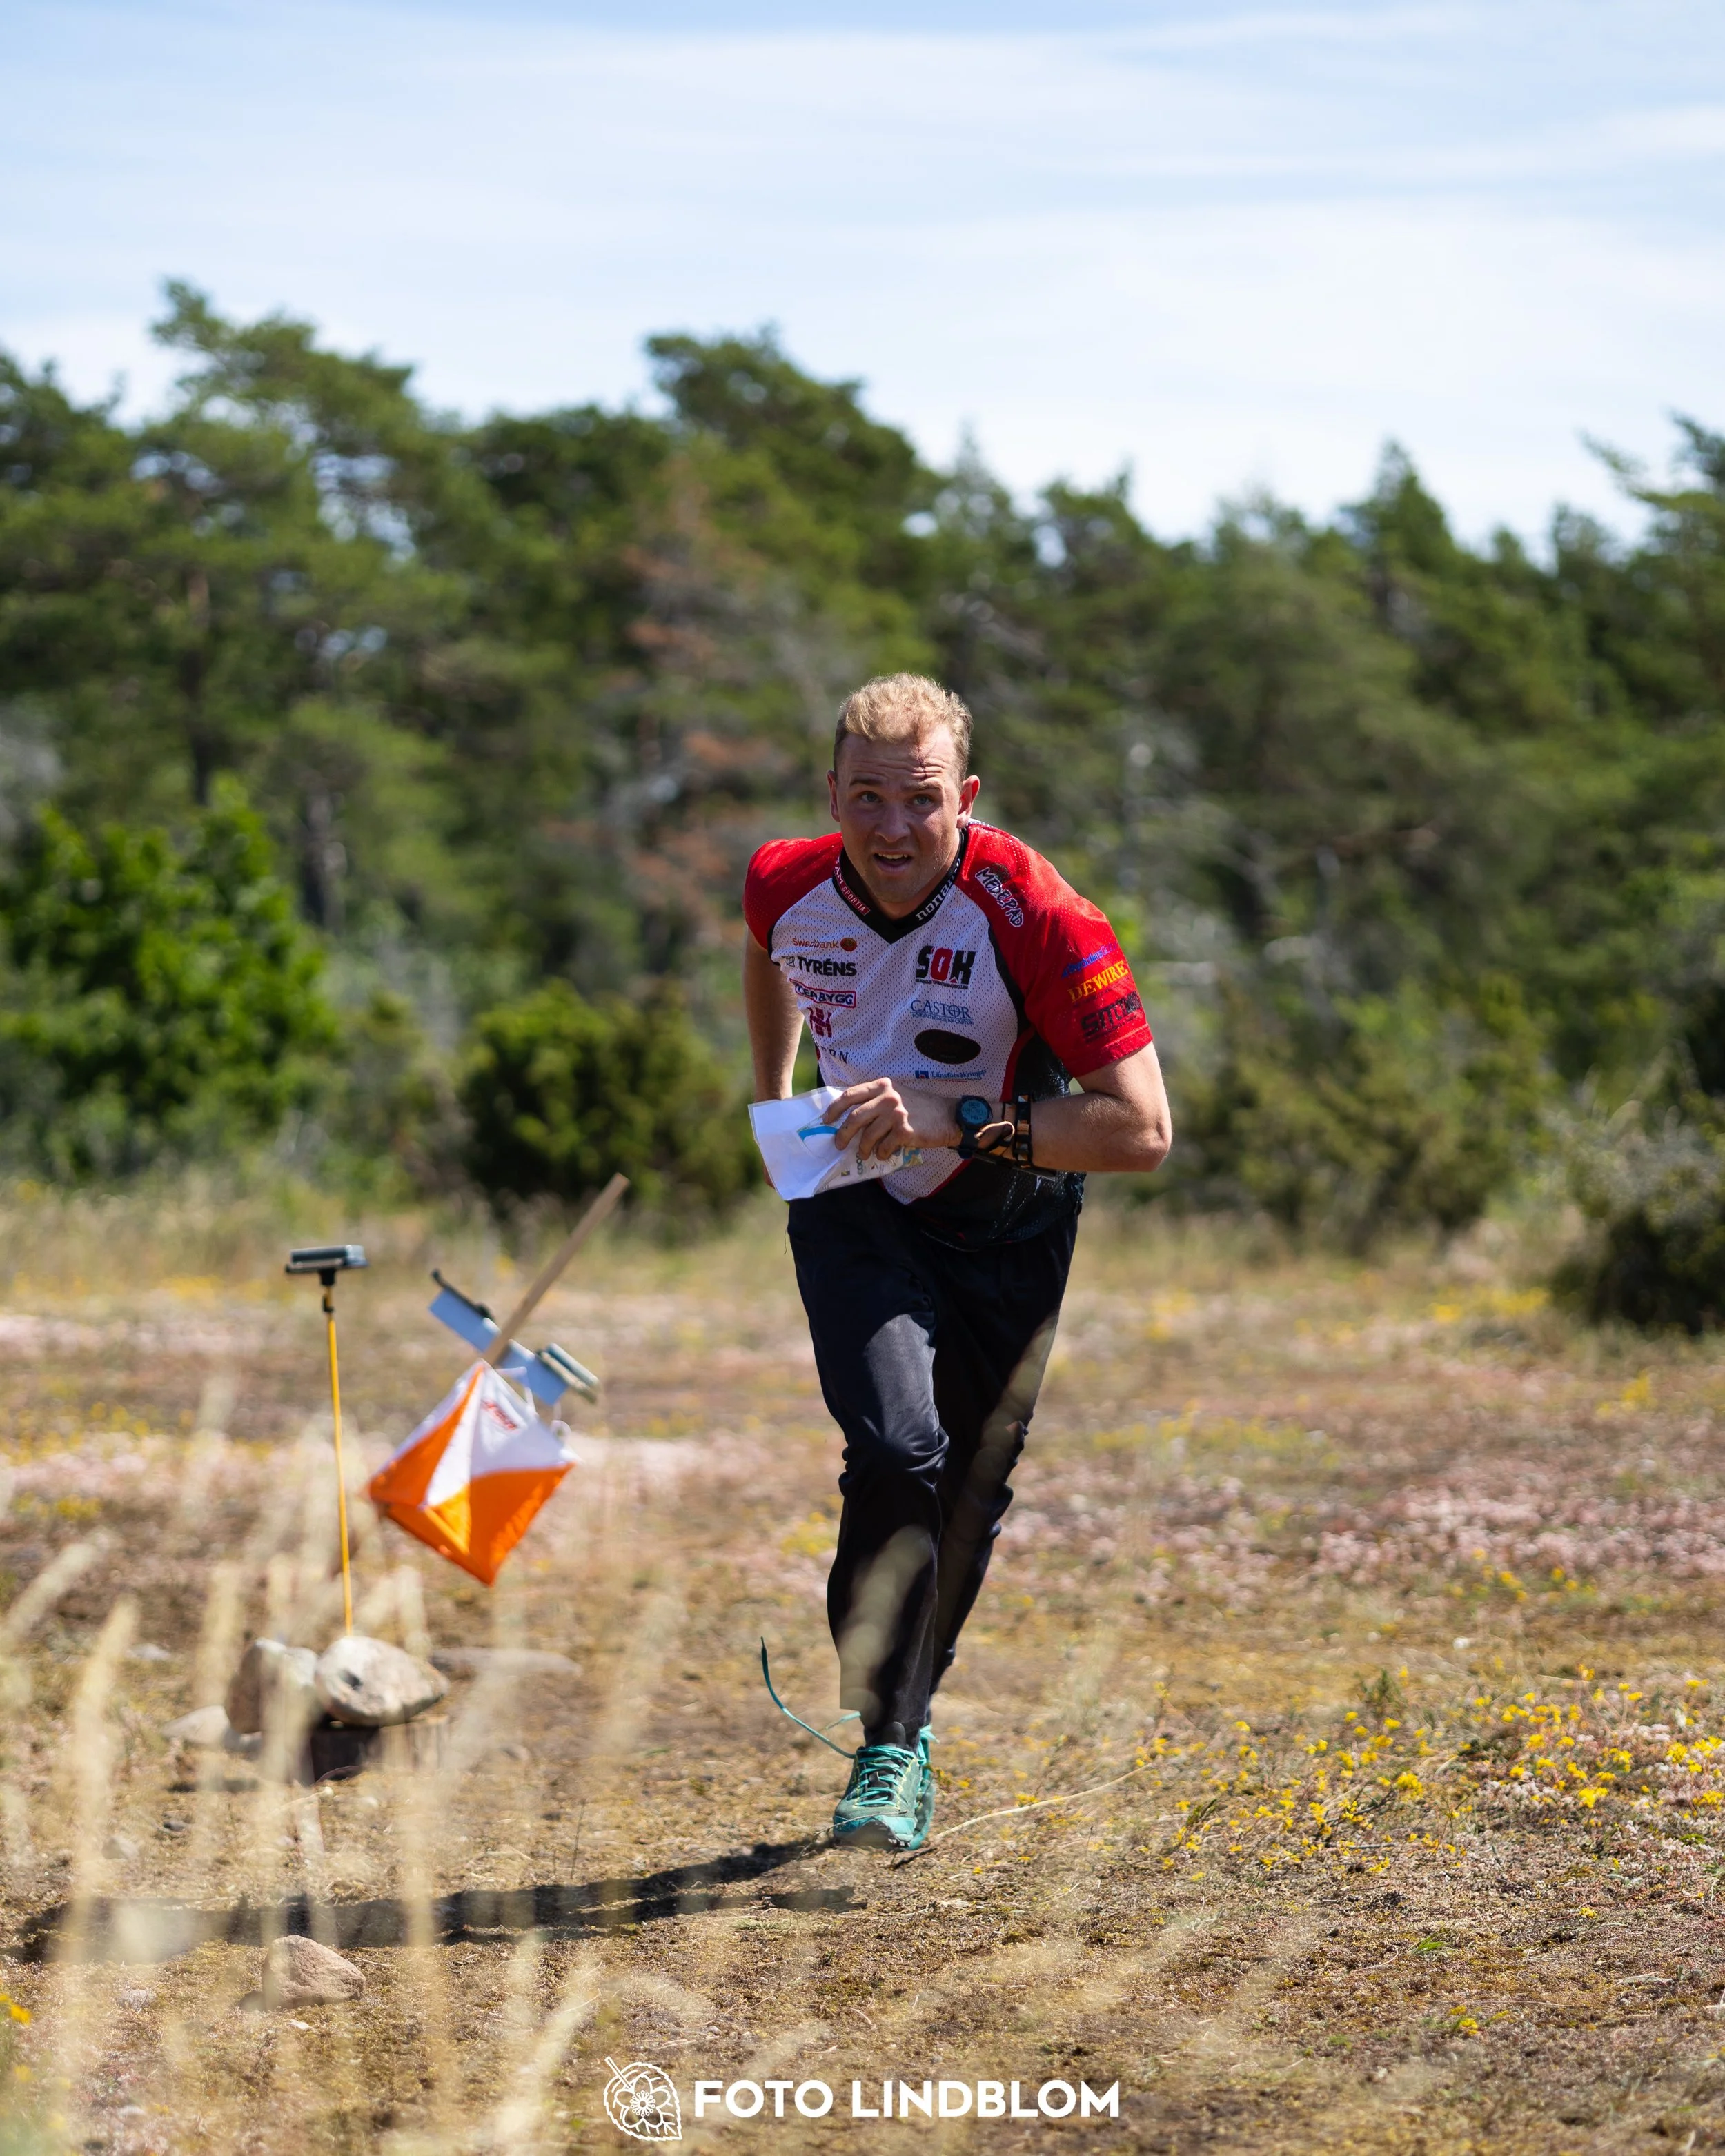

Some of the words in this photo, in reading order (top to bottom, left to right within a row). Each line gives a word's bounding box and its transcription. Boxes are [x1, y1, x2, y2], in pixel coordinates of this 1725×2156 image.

[842, 886, 866, 913] SPORTIA
[975, 867, 1024, 927] MEDELPAD
[792, 938, 839, 949] Swedbank
[797, 956, 857, 977] TYRÉNS
[916, 945, 976, 985] SOK
[1067, 960, 1129, 1002] DEWIRE
[911, 1000, 973, 1019] CASTOR
